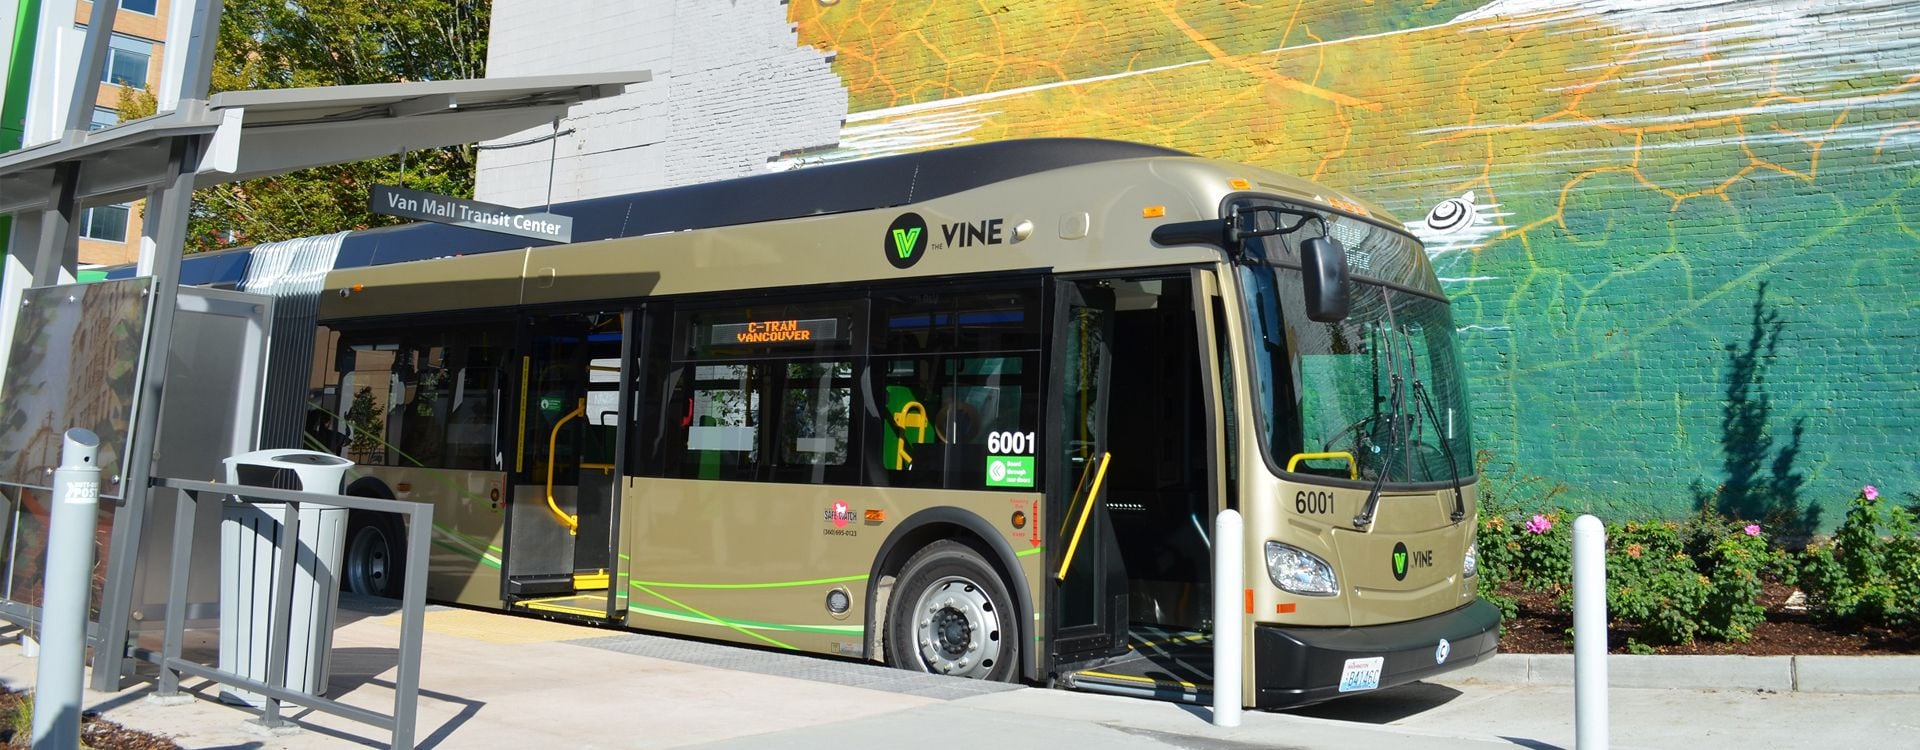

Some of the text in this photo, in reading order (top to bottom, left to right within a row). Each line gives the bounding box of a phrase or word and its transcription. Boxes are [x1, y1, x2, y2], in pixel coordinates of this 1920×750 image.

[387, 192, 561, 236] Van Mall Transit Center
[941, 218, 1004, 248] VINE
[737, 330, 810, 342] VANCOUVER
[748, 320, 797, 333] C-TRAN
[988, 431, 1035, 454] 6001
[1296, 490, 1334, 514] 6001
[824, 511, 837, 520] SAFE
[1412, 550, 1433, 568] VINE
